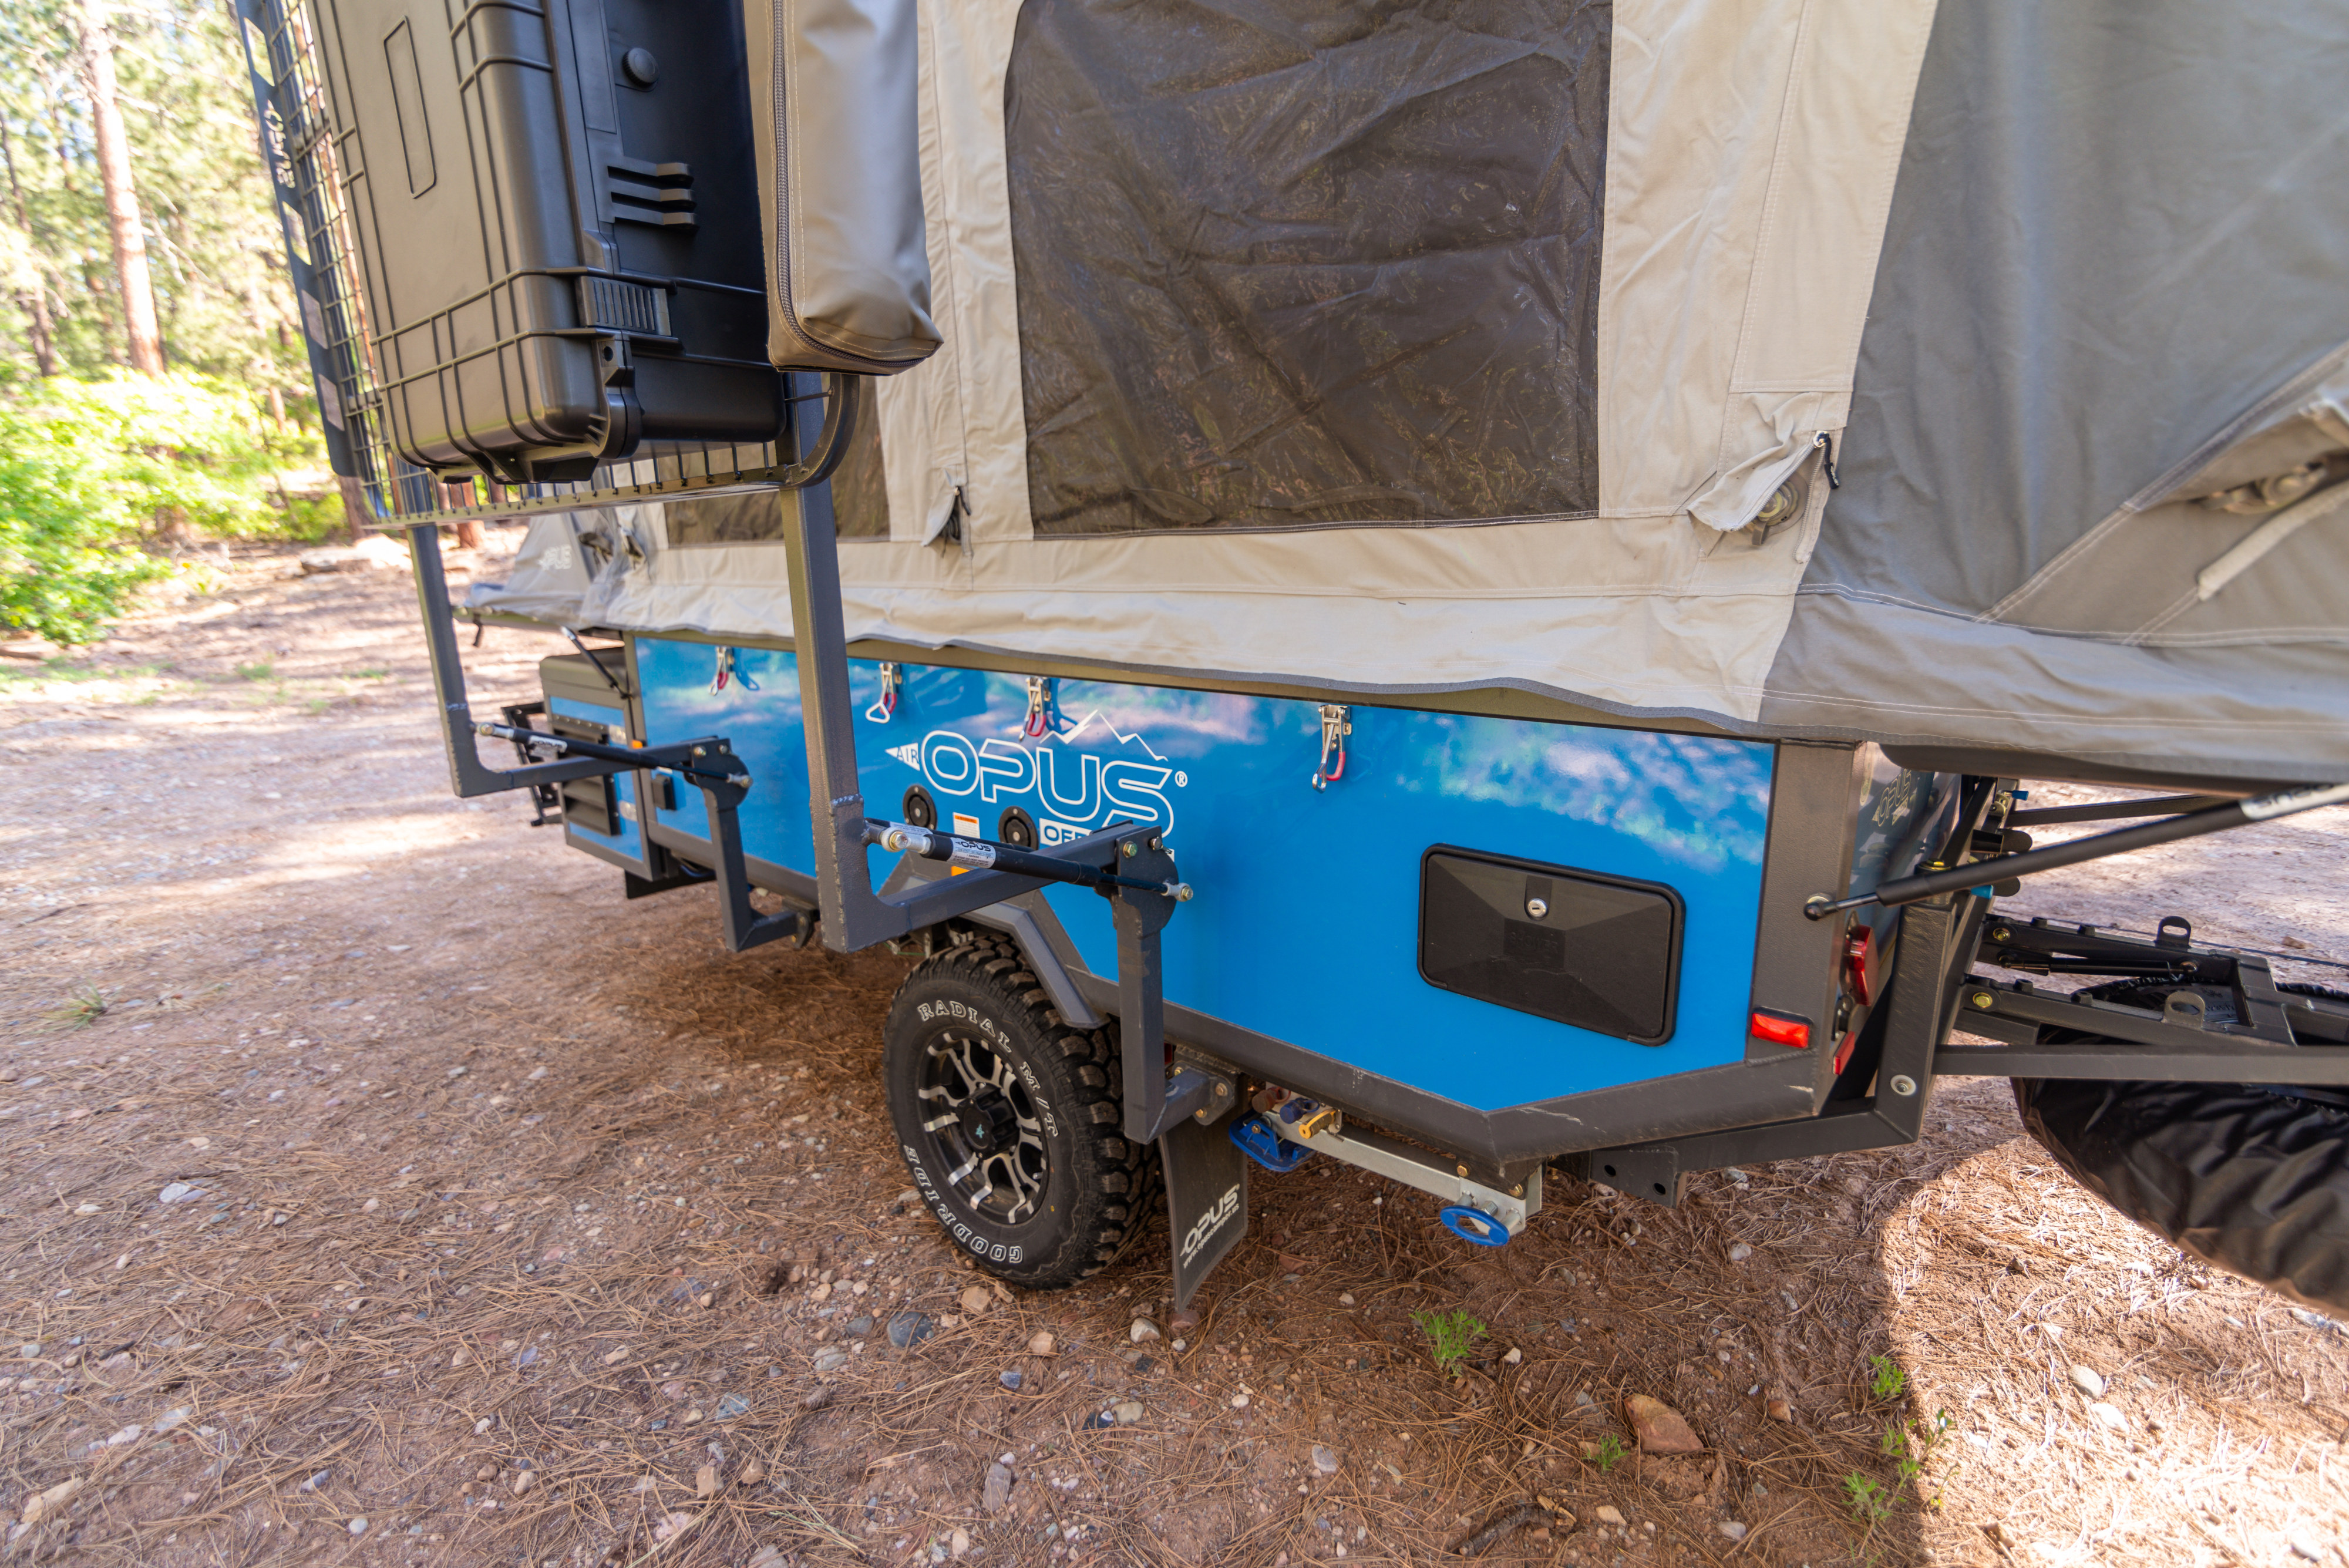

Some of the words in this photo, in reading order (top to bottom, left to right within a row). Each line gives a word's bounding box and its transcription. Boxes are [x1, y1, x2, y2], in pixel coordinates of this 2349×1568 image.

[897, 746, 920, 764] AIR
[921, 730, 1174, 839] OPUS
[1877, 768, 1912, 827] OPUS
[961, 840, 991, 852] OPUS
[1510, 931, 1560, 954] SHOWER
[917, 1000, 1012, 1053] RADIAL
[903, 1145, 1023, 1264] GOODRIDE
[1184, 1184, 1239, 1254] OPUS
